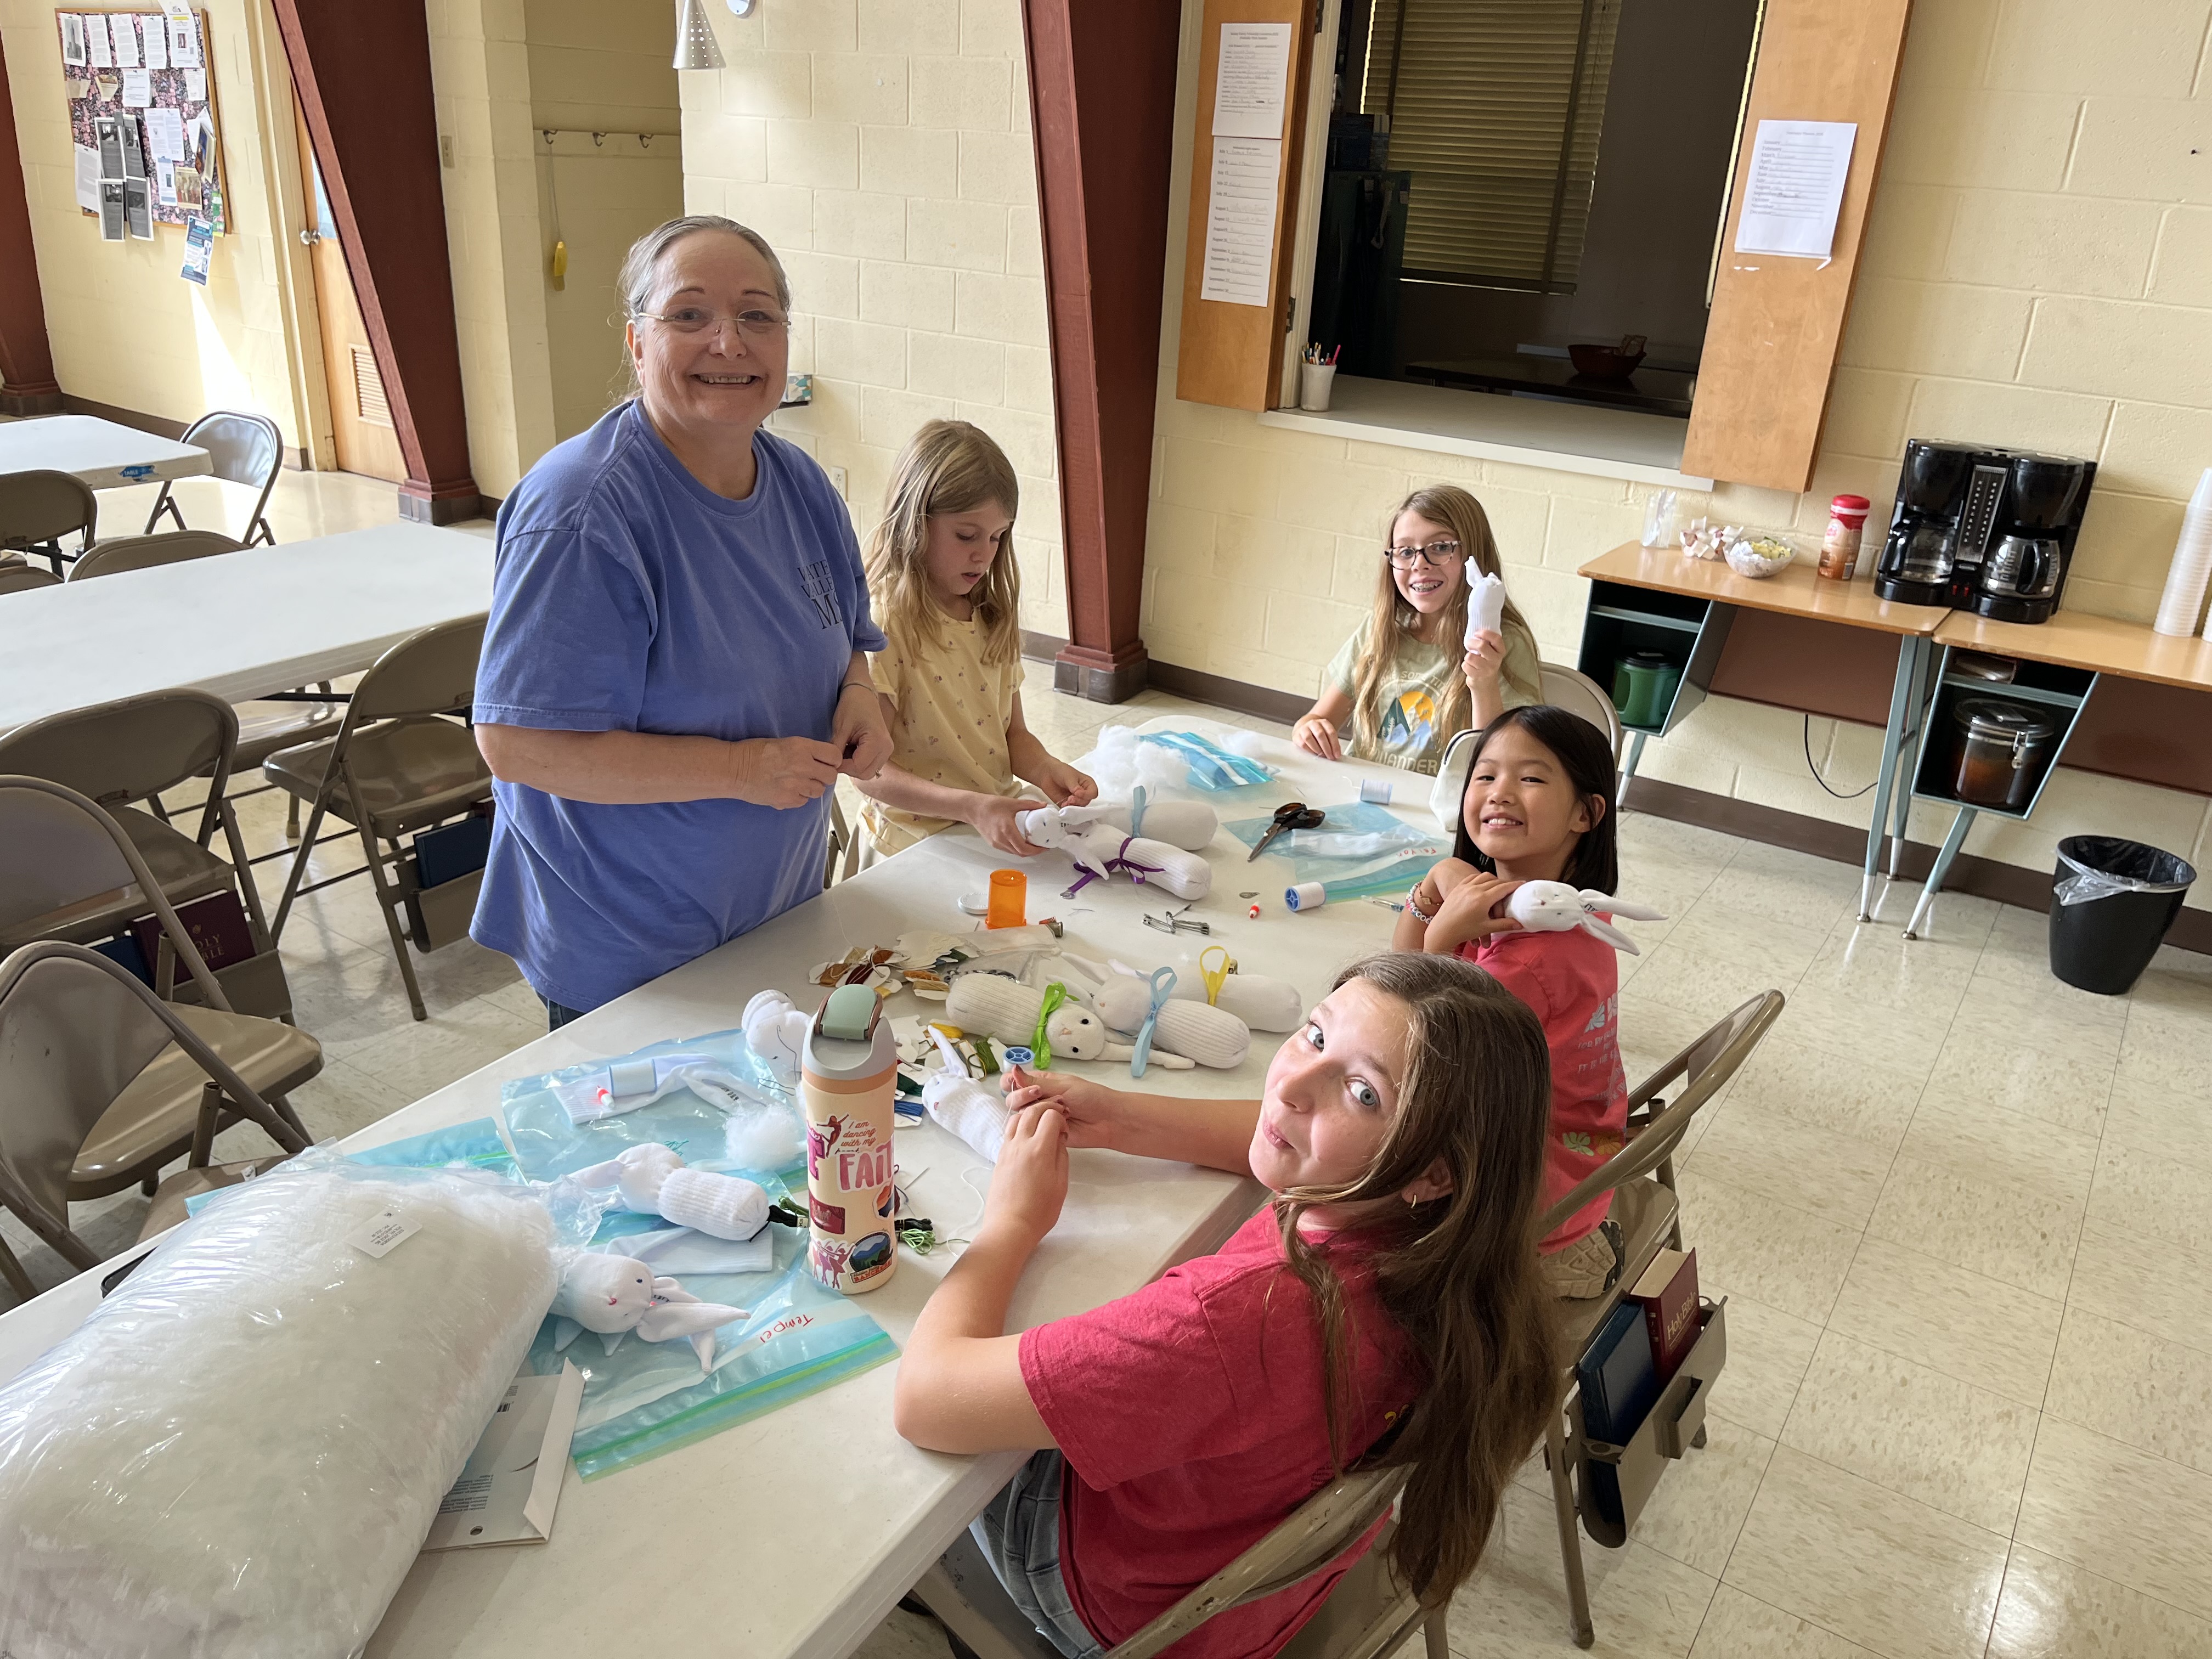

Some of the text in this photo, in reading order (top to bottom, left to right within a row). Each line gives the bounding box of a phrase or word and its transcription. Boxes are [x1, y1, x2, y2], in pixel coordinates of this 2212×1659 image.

[800, 576, 836, 599] VALLE
[196, 933, 221, 950] OLY
[202, 947, 225, 961] BLE
[842, 1128, 877, 1138] dancing
[840, 1137, 877, 1147] with my
[839, 1141, 893, 1190] FAIT
[1667, 1313, 1683, 1340] Holy
[1681, 1291, 1697, 1321] Bible
